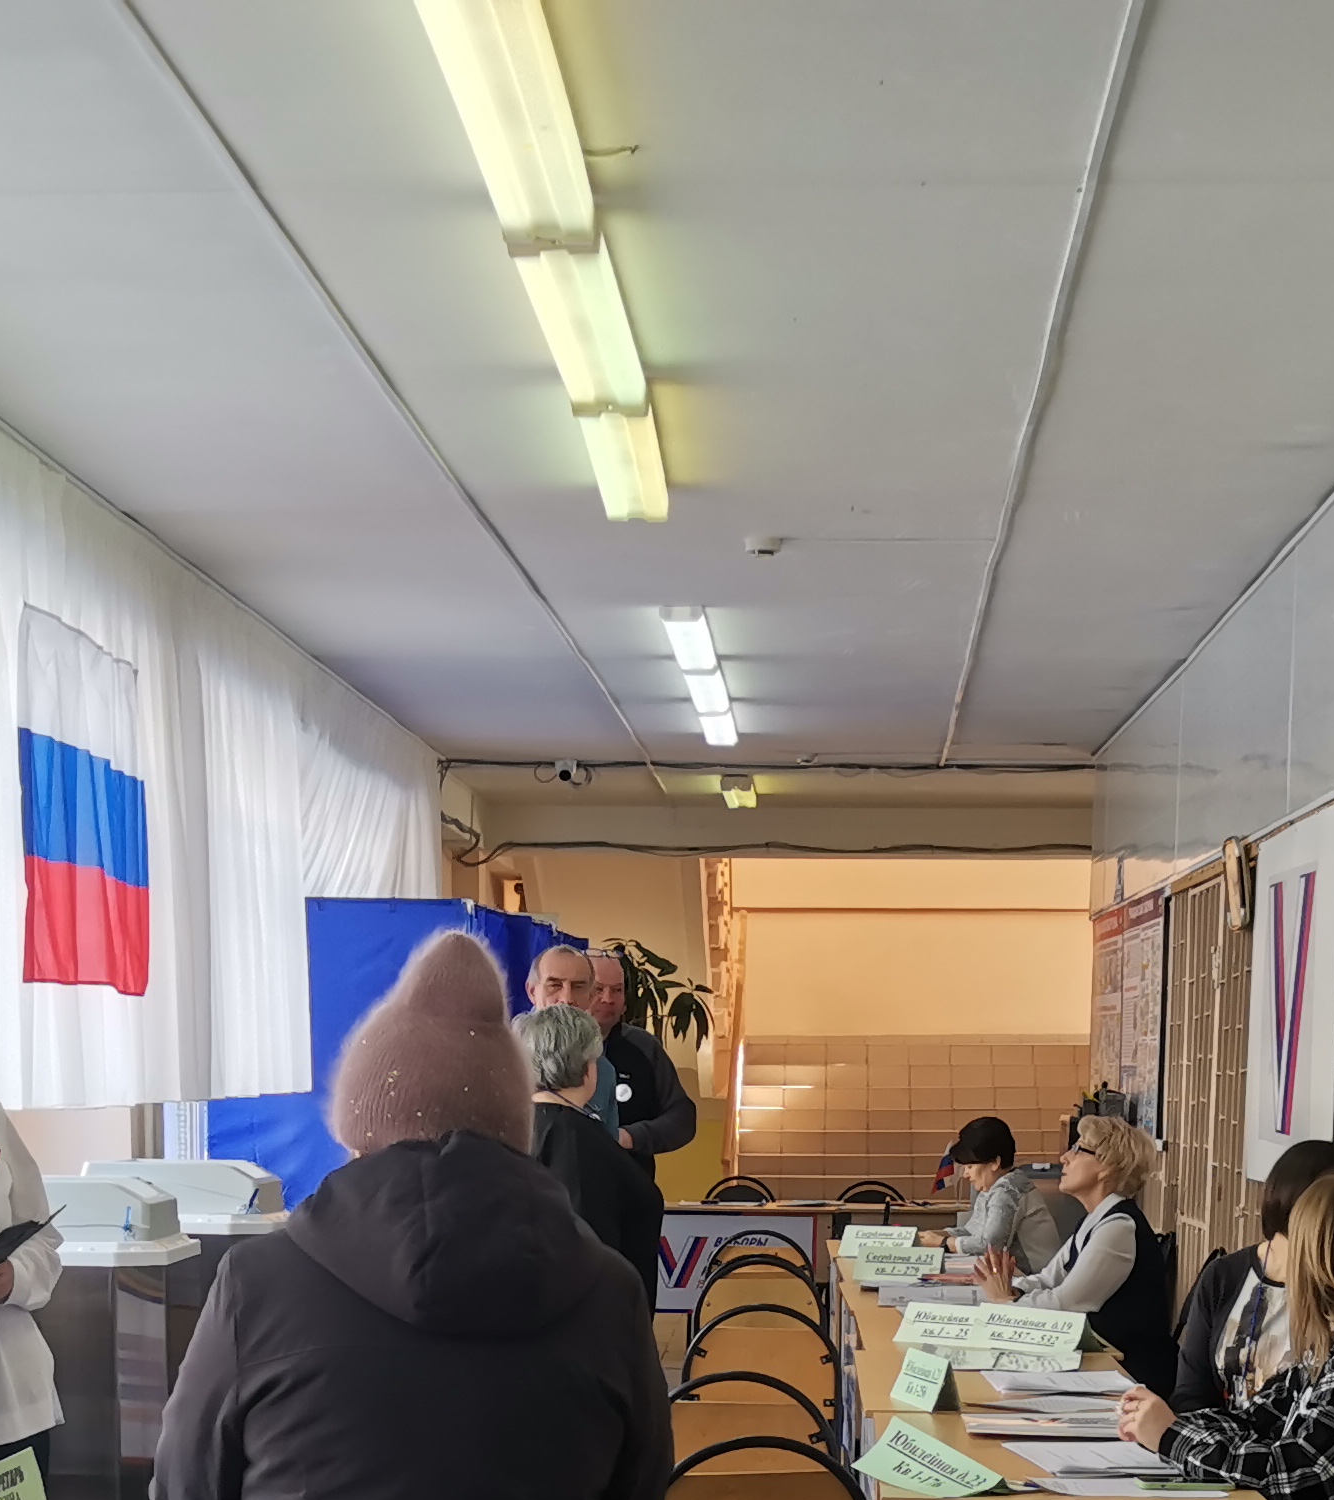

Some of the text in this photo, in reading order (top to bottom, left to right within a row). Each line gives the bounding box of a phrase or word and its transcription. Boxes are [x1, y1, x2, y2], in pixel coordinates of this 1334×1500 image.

[915, 1310, 970, 1323] Юбилейная
[987, 1312, 1073, 1332] Юбилейная д.19
[889, 1430, 959, 1476] Юбилейная
